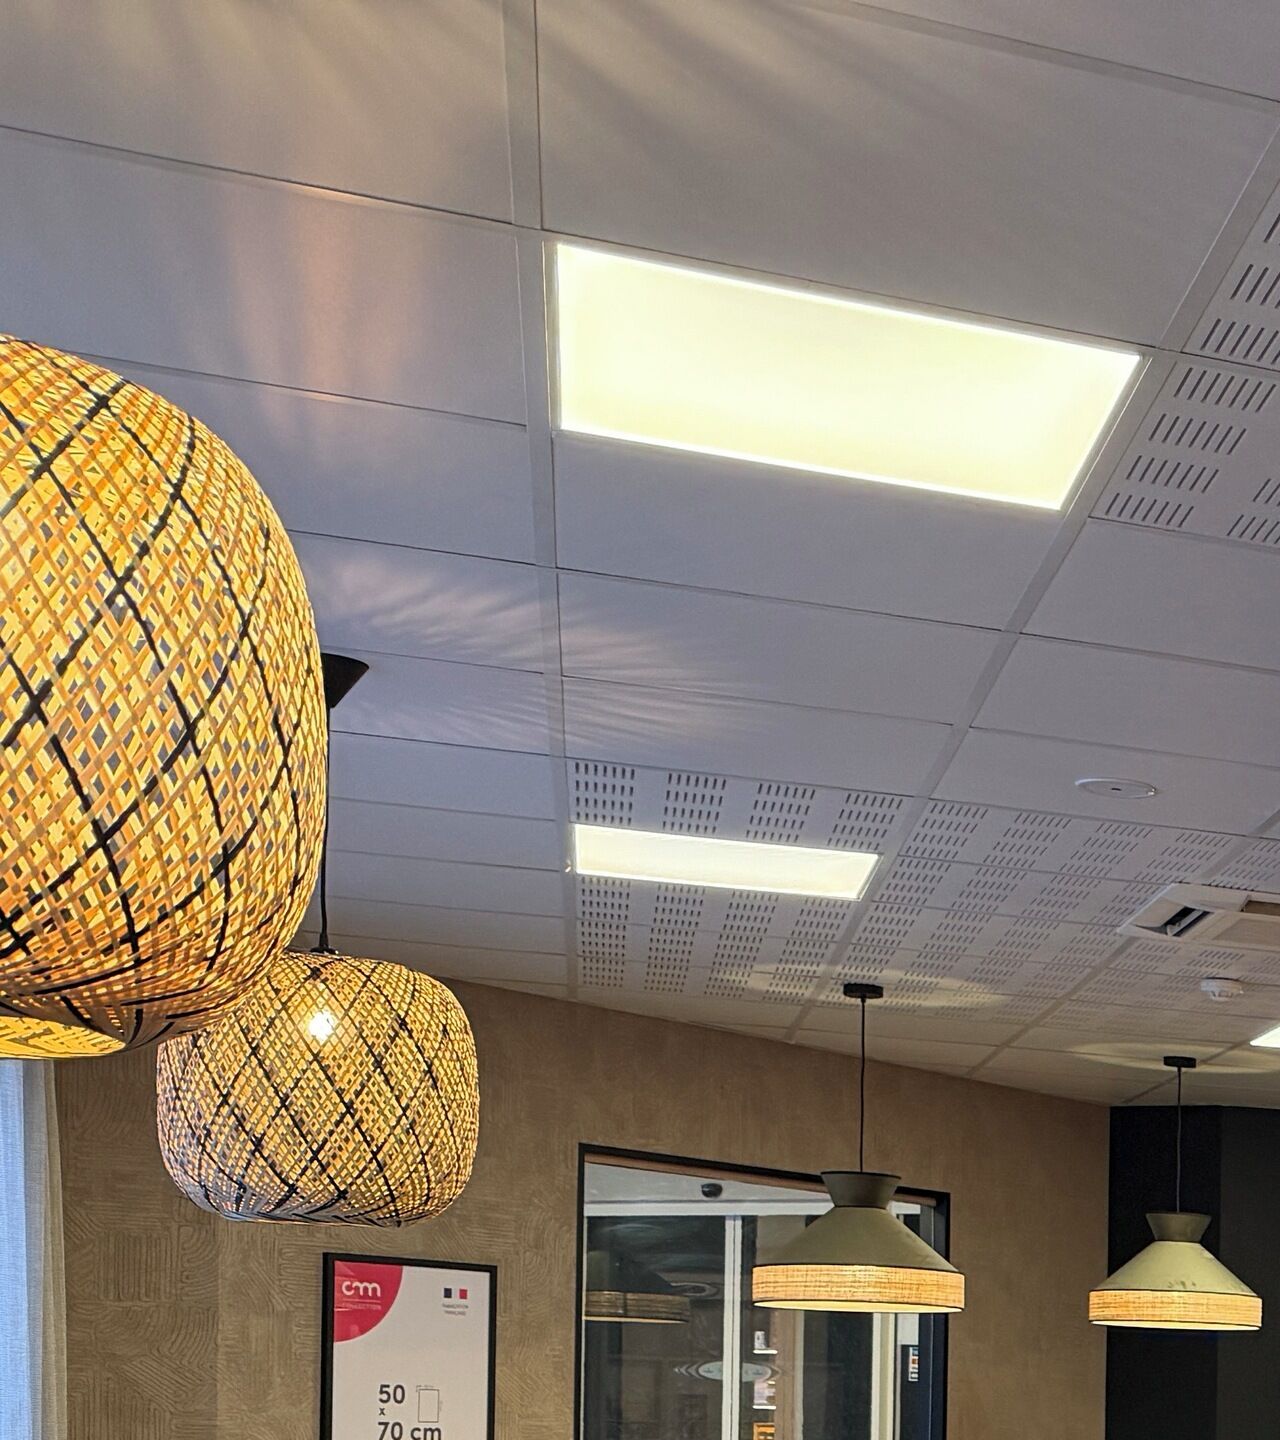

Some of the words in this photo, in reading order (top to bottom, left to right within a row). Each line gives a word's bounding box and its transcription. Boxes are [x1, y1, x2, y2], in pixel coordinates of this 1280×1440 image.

[378, 1384, 405, 1404] 50
[377, 1421, 403, 1440] 70
[410, 1427, 442, 1440] cm
